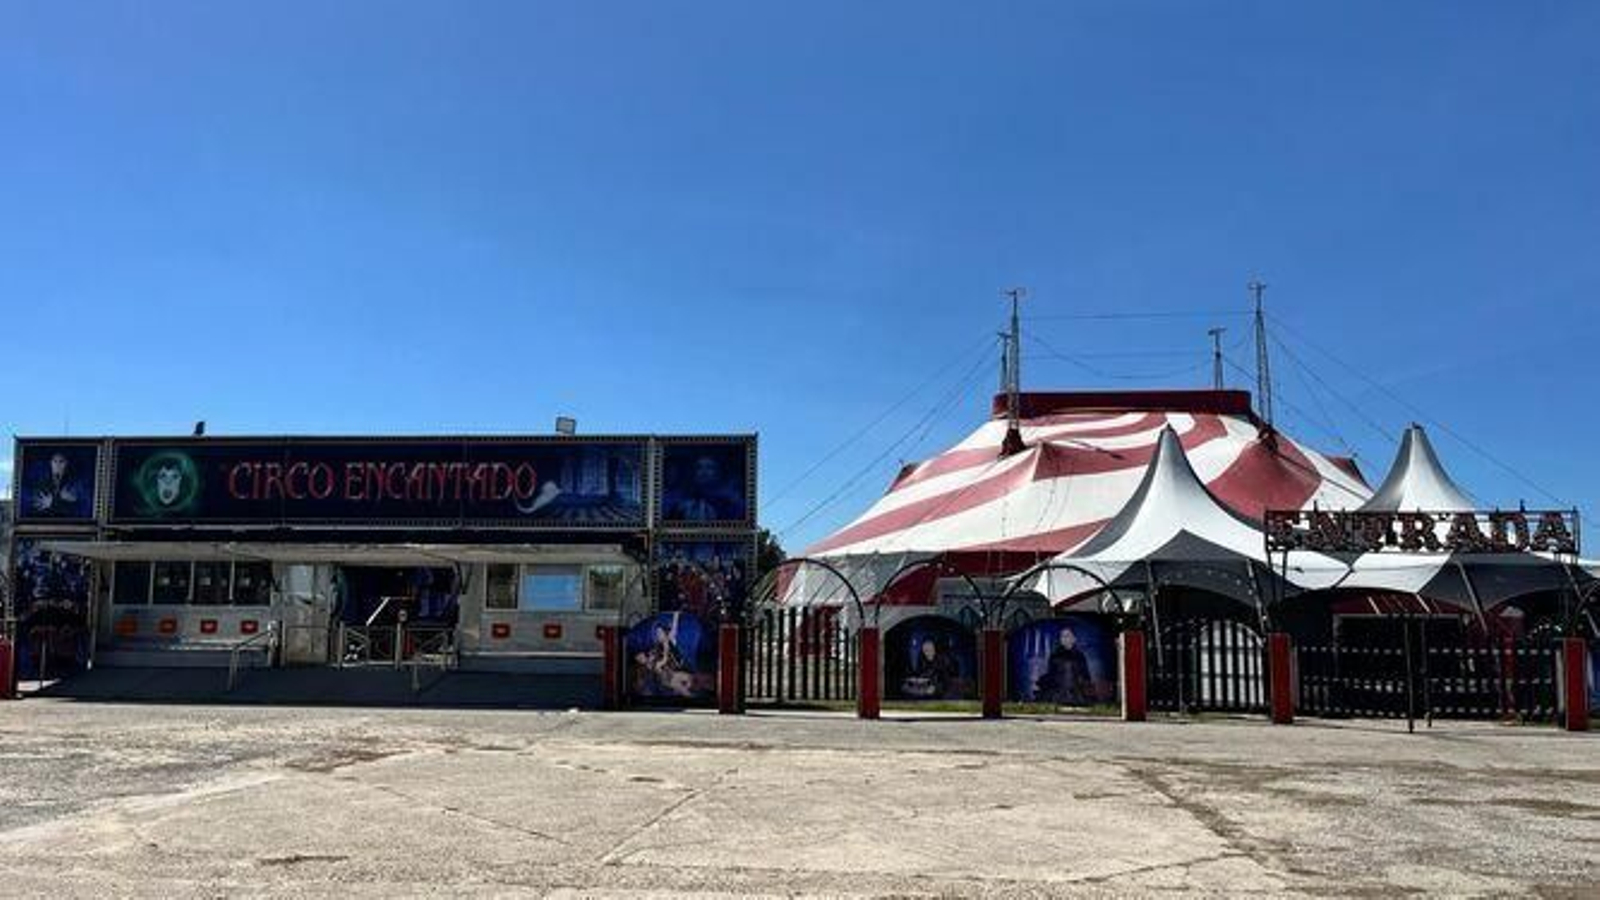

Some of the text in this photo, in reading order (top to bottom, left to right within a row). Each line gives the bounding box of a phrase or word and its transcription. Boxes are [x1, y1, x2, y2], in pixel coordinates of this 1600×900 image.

[229, 462, 537, 504] CIRCO ENCANTADO
[1265, 511, 1575, 553] ENTRADA
